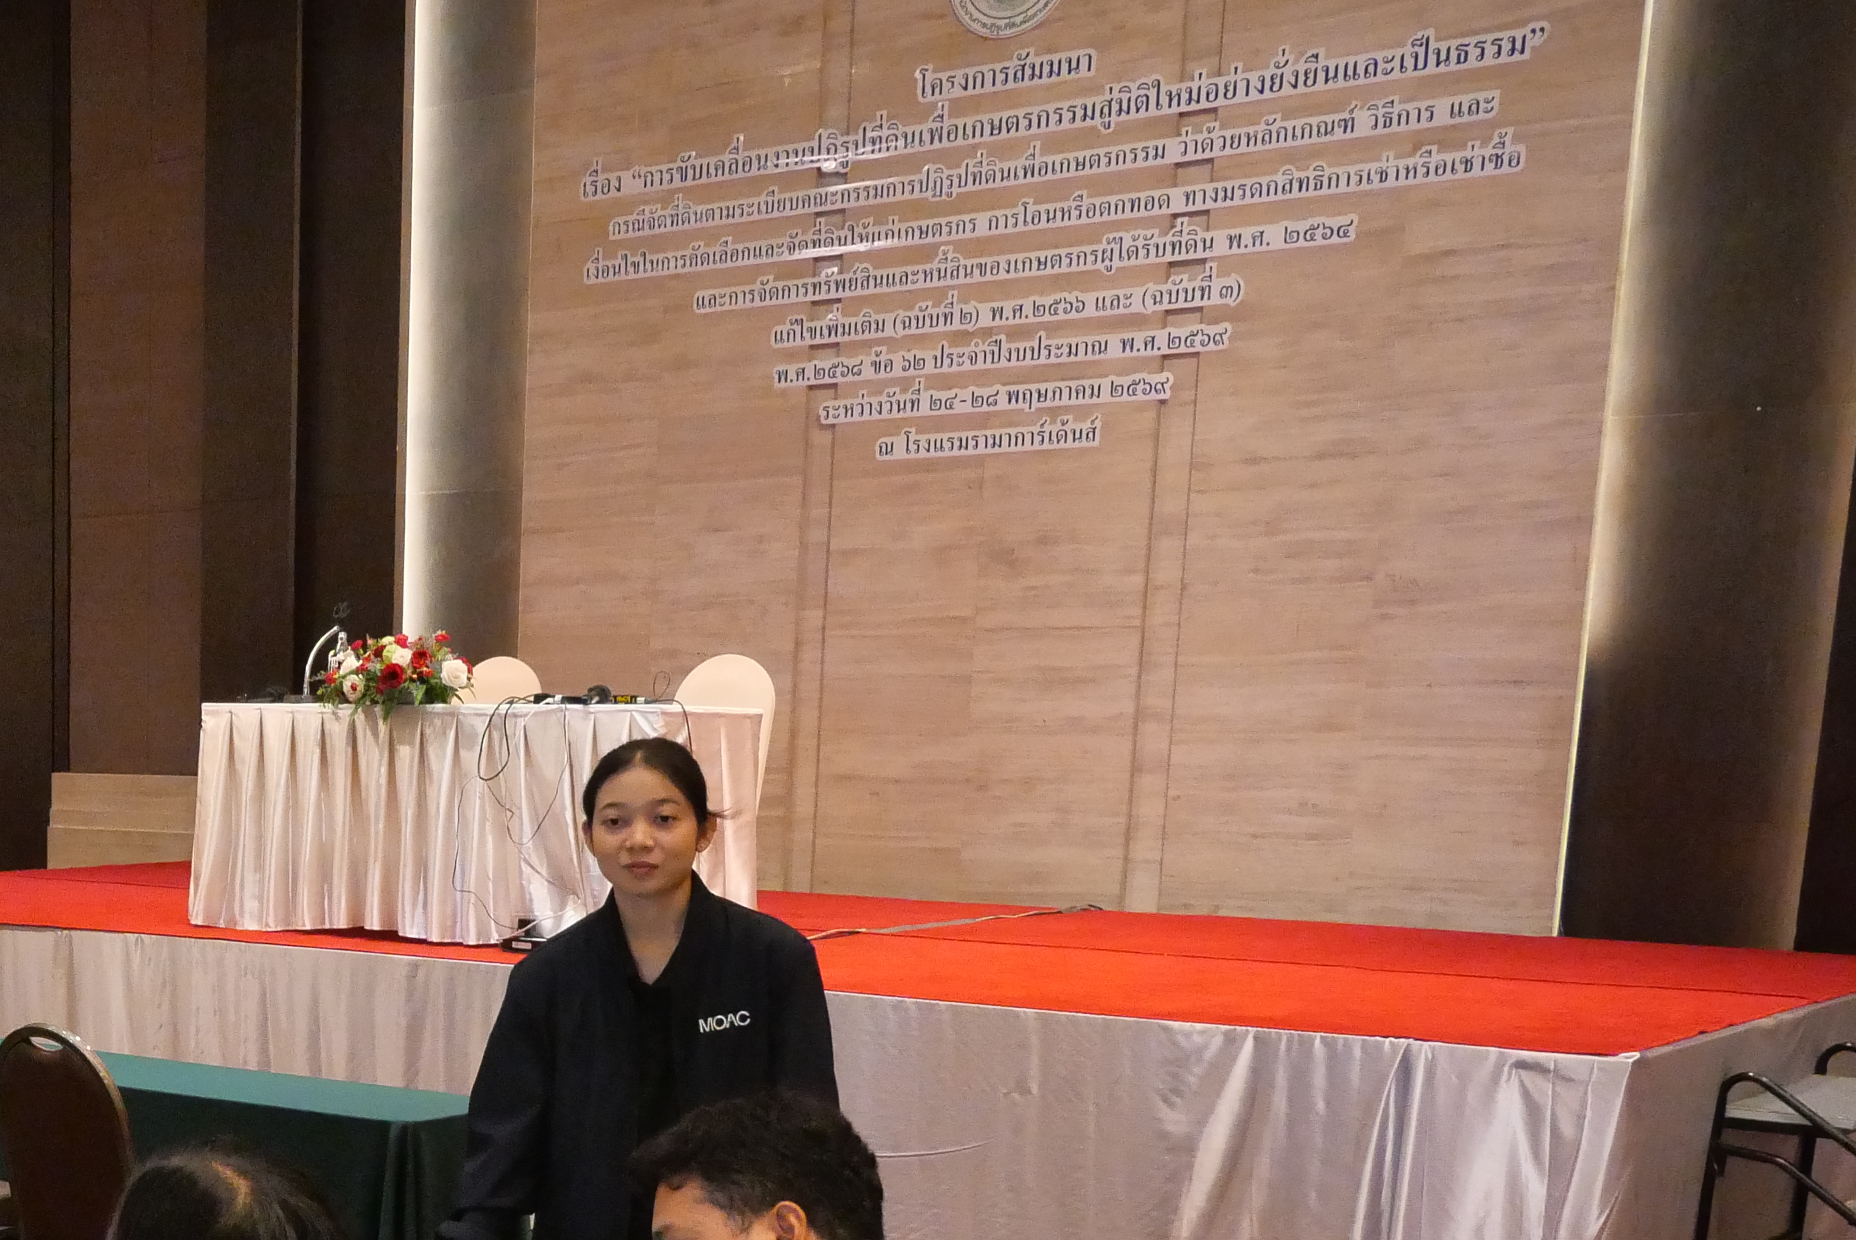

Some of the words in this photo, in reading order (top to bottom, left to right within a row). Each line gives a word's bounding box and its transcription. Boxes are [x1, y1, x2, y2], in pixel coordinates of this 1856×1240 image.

[918, 50, 1093, 99] โครงการสัมมนา
[1179, 103, 1356, 158] ว่าด้วยหลักเกณฑ์
[1369, 98, 1436, 131] วิธีการ
[1449, 95, 1495, 119] และ
[582, 161, 622, 199] เรื่อง
[988, 192, 1171, 232] การโอนหรือตกทอด
[1183, 131, 1522, 207] ทางมรดกสิทธิการเช่าหรือเช่าซื้อ
[773, 307, 886, 345] แก้ไขเพิ่มเติม
[1094, 293, 1133, 312] และ
[870, 350, 894, 374] ข้อ
[932, 334, 1108, 370] ประจำปีงบประมาณ
[821, 381, 922, 420] ระหว่างวันที่
[1006, 384, 1102, 410] พฤษภาคม
[1110, 377, 1170, 398] ๒๕๖๙
[878, 441, 894, 457] ณ
[903, 416, 1098, 455] โรงแรมรามาการ์เด้นส์
[698, 1010, 751, 1033] MOAC
